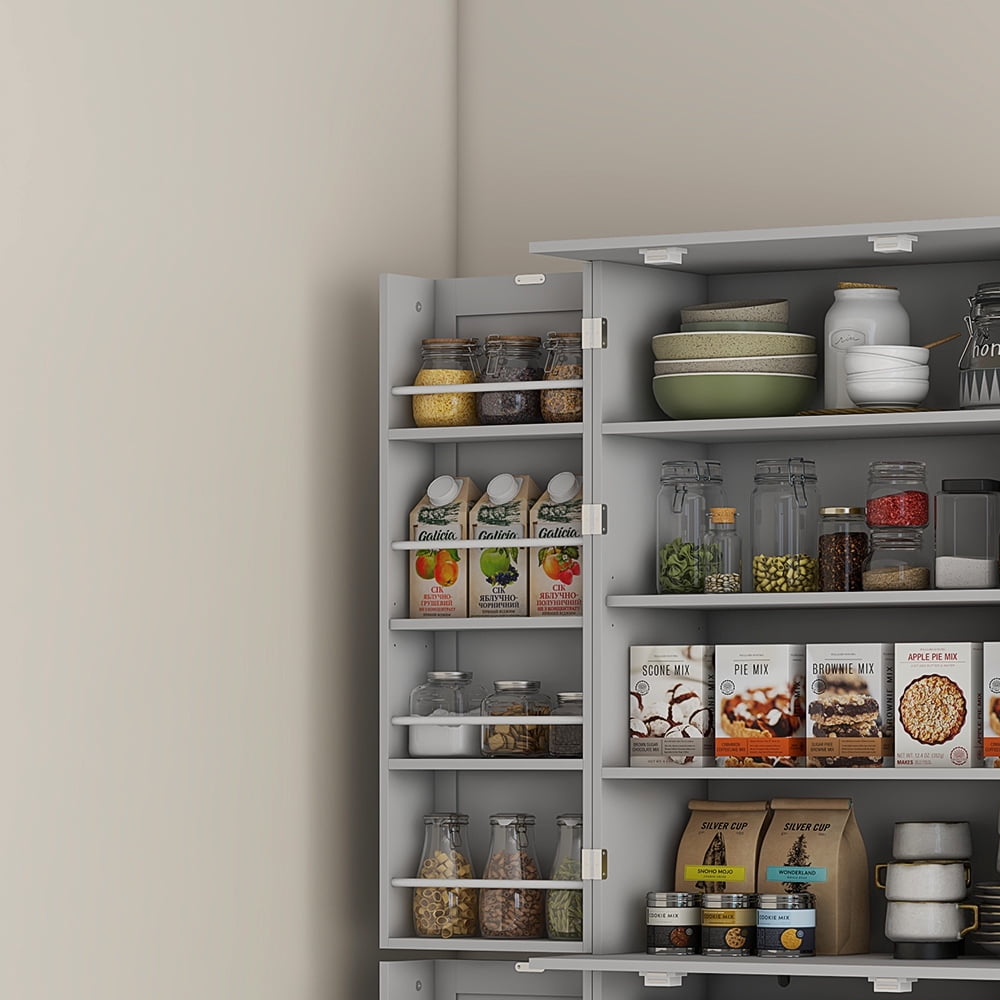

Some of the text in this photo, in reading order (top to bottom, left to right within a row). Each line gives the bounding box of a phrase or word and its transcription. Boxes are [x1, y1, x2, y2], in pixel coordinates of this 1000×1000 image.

[418, 530, 457, 541] Galicia
[478, 530, 518, 540] Galicia
[538, 527, 581, 539] Galicia
[908, 653, 930, 661] APPLE
[932, 653, 943, 661] PIE
[642, 664, 690, 676] SCONE MIX
[734, 663, 769, 675] PIE MIX
[812, 663, 875, 675] BROWNIE MIX
[701, 822, 748, 830] SILVER CUP
[784, 823, 831, 832] SILVER CUP
